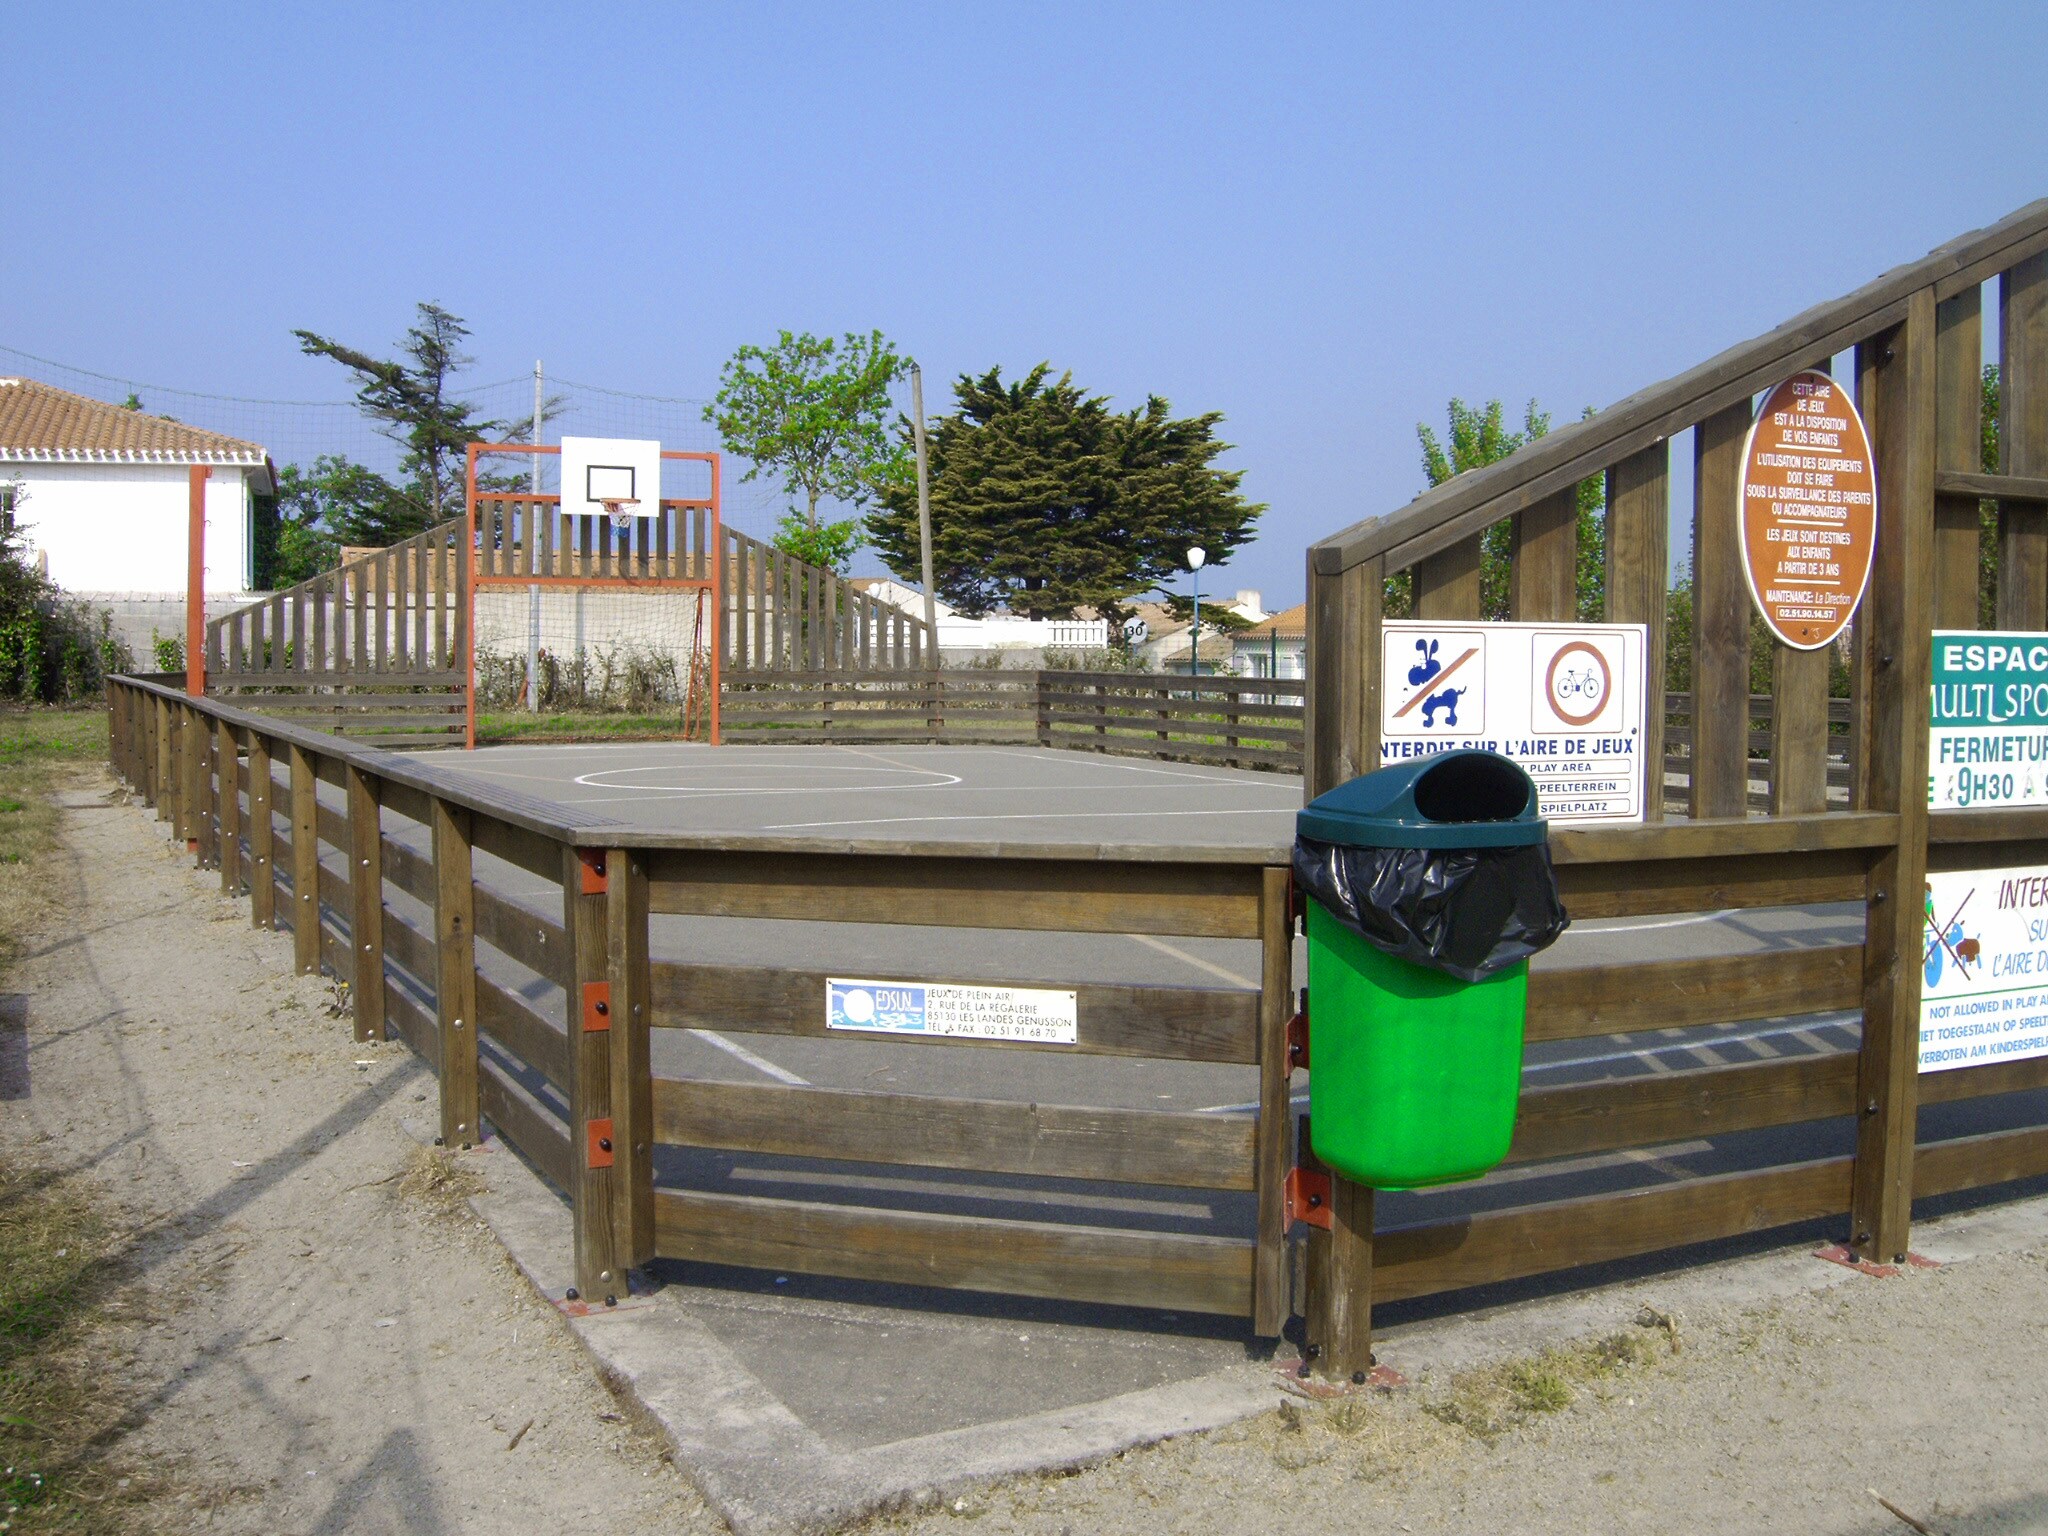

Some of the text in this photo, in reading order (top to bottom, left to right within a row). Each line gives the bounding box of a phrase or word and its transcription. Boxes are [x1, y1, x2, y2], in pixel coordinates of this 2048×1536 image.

[1792, 382, 1830, 398] CETTE AIRE
[1797, 399, 1825, 413] DE JEUX
[1774, 412, 1788, 426] EST
[1795, 414, 1805, 427] LA
[1806, 416, 1847, 431] DISPOSITION
[1782, 430, 1839, 446] DE VOS ENFANTS
[1757, 452, 1801, 468] L'UTILISATION
[1802, 456, 1816, 470] DES
[1787, 471, 1834, 487] DOIT SE FAIRE
[1746, 484, 1871, 505] SOUS LA SURVEILLANCE DES PARENTS
[1772, 502, 1848, 519] OU ACCOMPAGNATEURS
[1766, 528, 1851, 545] LES JEUX SONT DESTINES
[1787, 546, 1831, 560] AUX ENFANTS
[1784, 562, 1807, 575] PARTIR
[1808, 563, 1818, 575] DE
[1819, 563, 1824, 575] 3
[1825, 564, 1840, 576] ANS
[1128, 626, 1143, 636] 30
[1506, 740, 1559, 756] L'AIRE
[1565, 739, 1586, 754] DE
[1592, 738, 1634, 754] JEUX
[1530, 764, 1558, 772] PLAY
[1562, 763, 1592, 772] AREA
[1541, 802, 1608, 813] SPIELPLATZ
[1992, 951, 2034, 978] L'AIRE
[927, 988, 1010, 1001] JEUX DE PLEIN AIR
[940, 1001, 956, 1010] RUE
[960, 1002, 972, 1011] DE
[975, 1003, 986, 1011] LA
[1930, 1005, 1951, 1020] NOT
[1954, 1000, 1999, 1016] ALLOWED
[2002, 998, 2013, 1011] IN
[2016, 996, 2038, 1009] PLAY
[928, 1011, 1072, 1027] 85130 LES LANDES GENUSSON
[958, 1024, 975, 1034] FAX
[984, 1025, 996, 1035] 02
[1000, 1027, 1010, 1036] 51
[1014, 1026, 1025, 1036] 91
[1030, 1028, 1041, 1037] 68
[1045, 1028, 1057, 1038] 70
[1938, 1022, 2000, 1040] TOEGESTAAN
[2003, 1019, 2016, 1032] OP
[1970, 1044, 1987, 1058] AM
